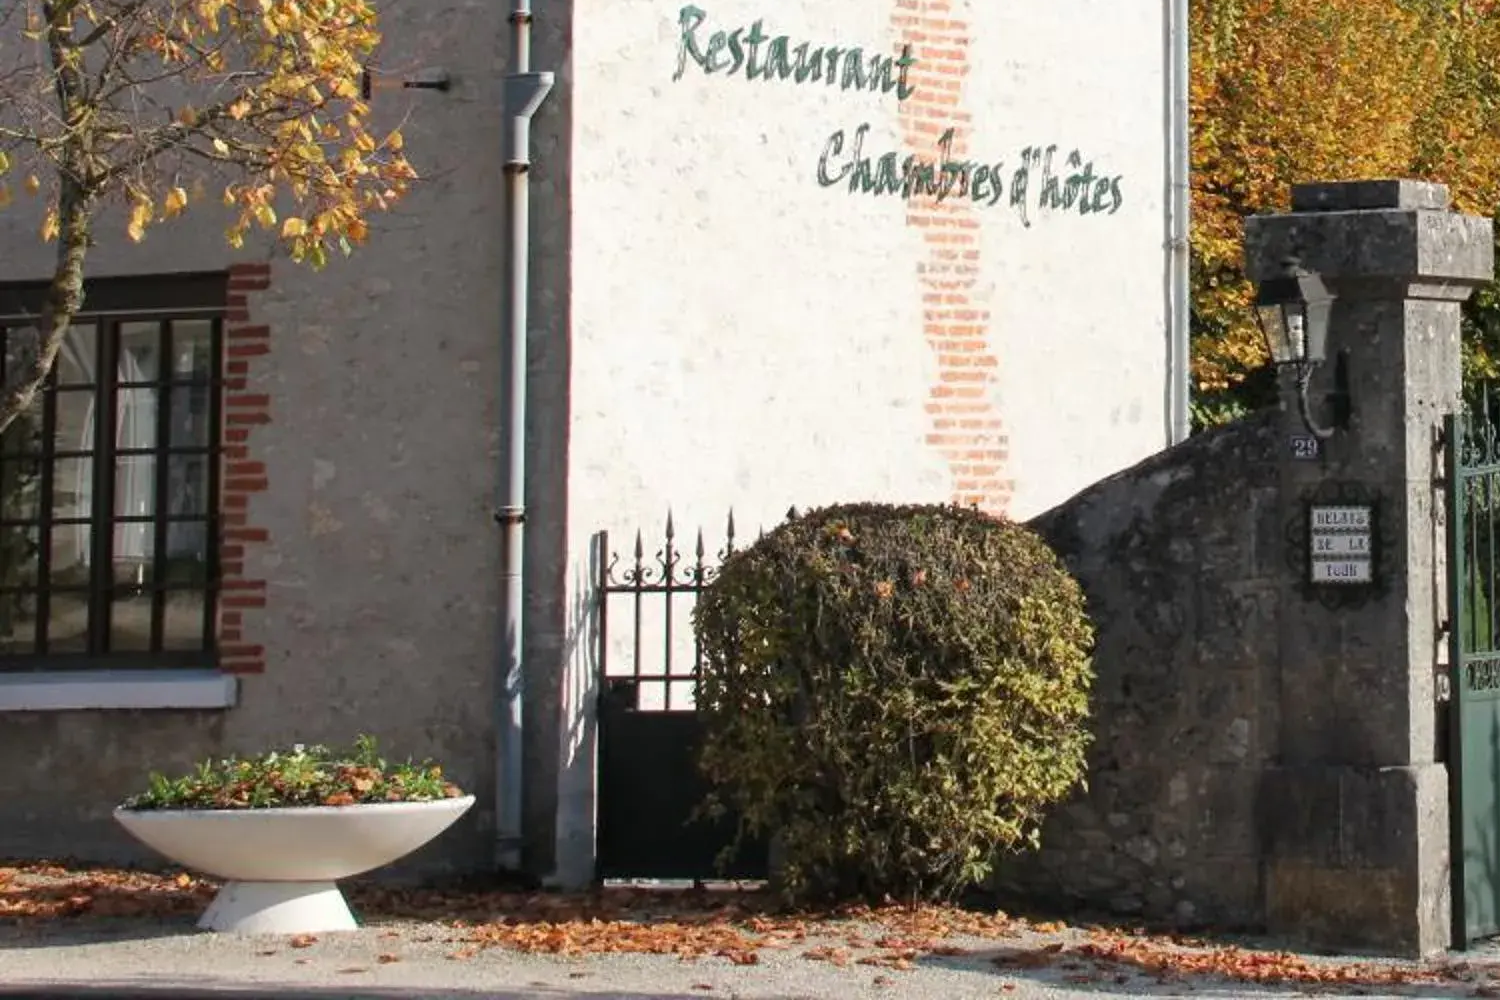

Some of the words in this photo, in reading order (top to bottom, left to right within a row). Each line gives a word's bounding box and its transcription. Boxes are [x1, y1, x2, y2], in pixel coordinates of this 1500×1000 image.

[672, 4, 918, 101] Restaurant
[817, 122, 1005, 206] Chambres
[1008, 144, 1124, 229] d'hôtes
[1295, 439, 1318, 457] 29
